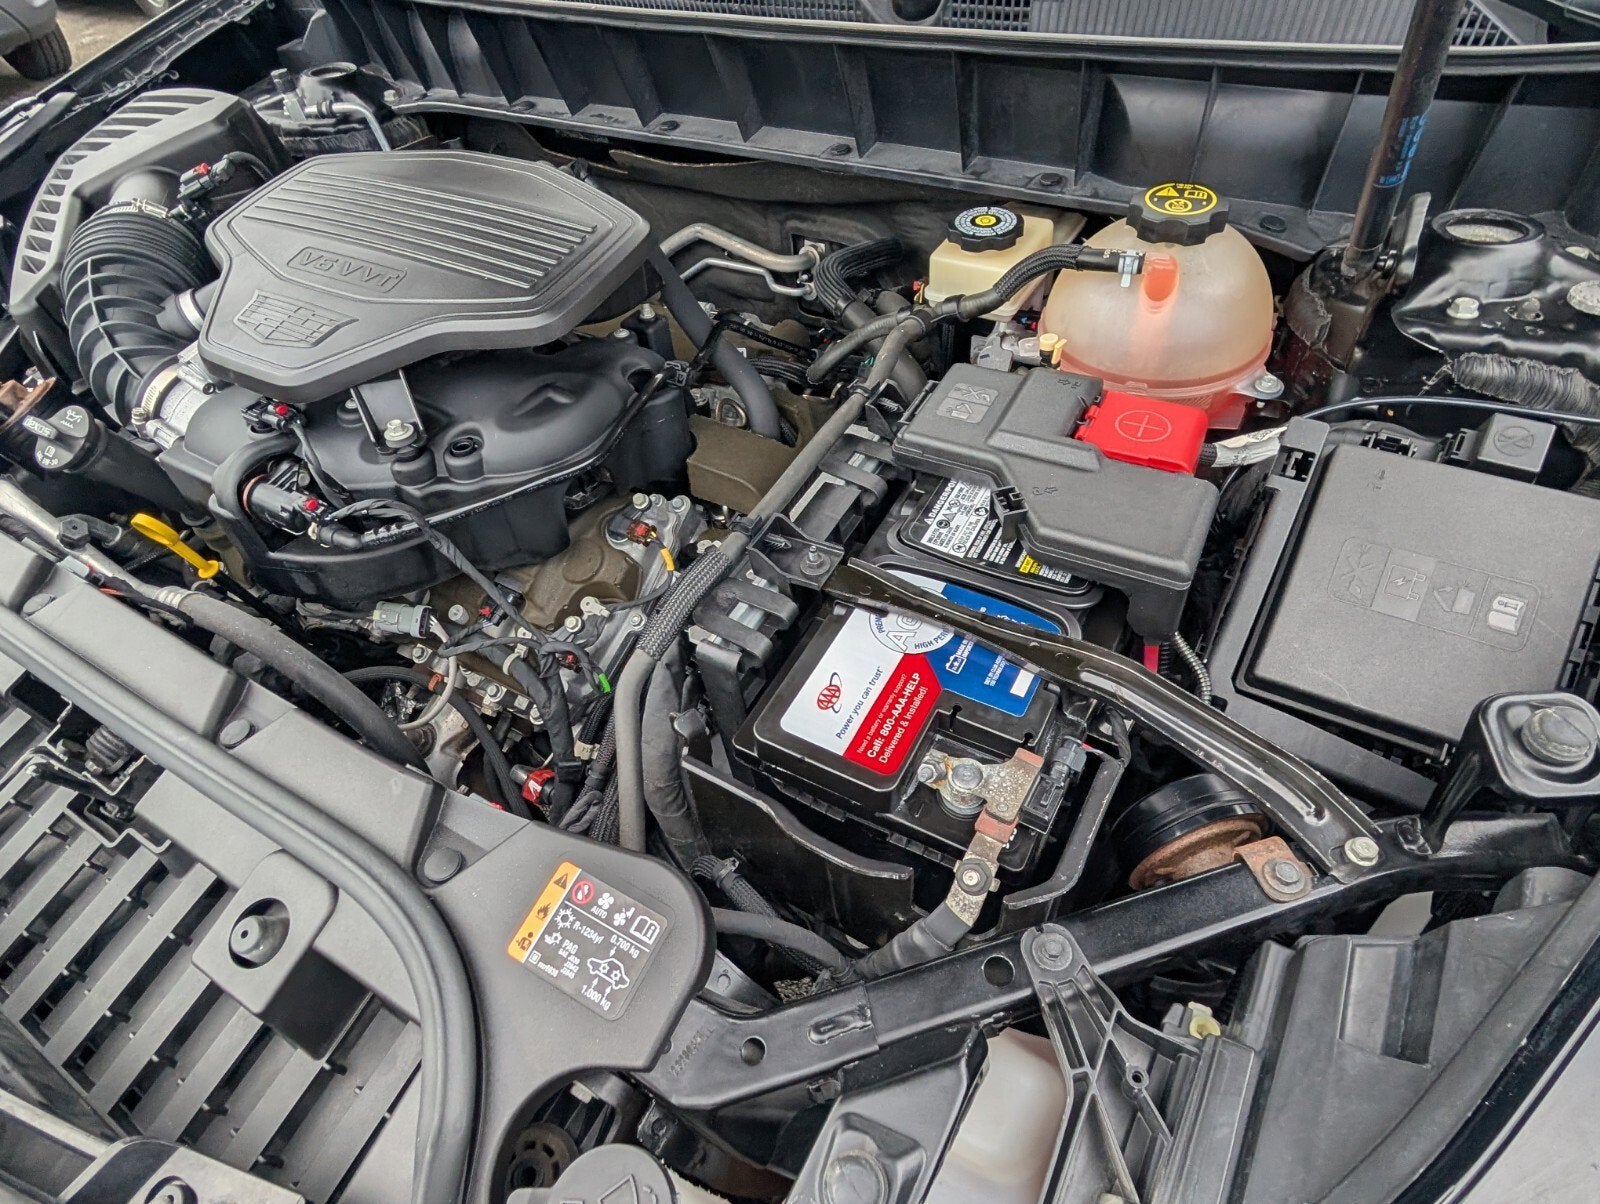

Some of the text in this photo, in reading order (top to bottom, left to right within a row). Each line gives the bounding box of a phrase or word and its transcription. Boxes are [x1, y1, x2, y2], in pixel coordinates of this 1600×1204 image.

[24, 417, 52, 438] dexos
[914, 640, 934, 650] HIGH
[817, 685, 841, 710] AAA
[836, 714, 853, 739] Power
[852, 699, 865, 716] you
[861, 686, 872, 699] can
[856, 738, 868, 753] Need
[867, 717, 882, 736] battery
[881, 692, 896, 714] warranty
[893, 673, 907, 693] support?
[867, 672, 920, 758] Call: 800-AAA-HELP
[879, 685, 927, 763] Delivered & Installed!
[591, 905, 607, 919] AUTO
[573, 921, 605, 945] R-1234yf
[562, 940, 579, 954] PAG
[610, 935, 640, 958] 0.700 kg
[581, 984, 611, 1011] 1.000 kg
